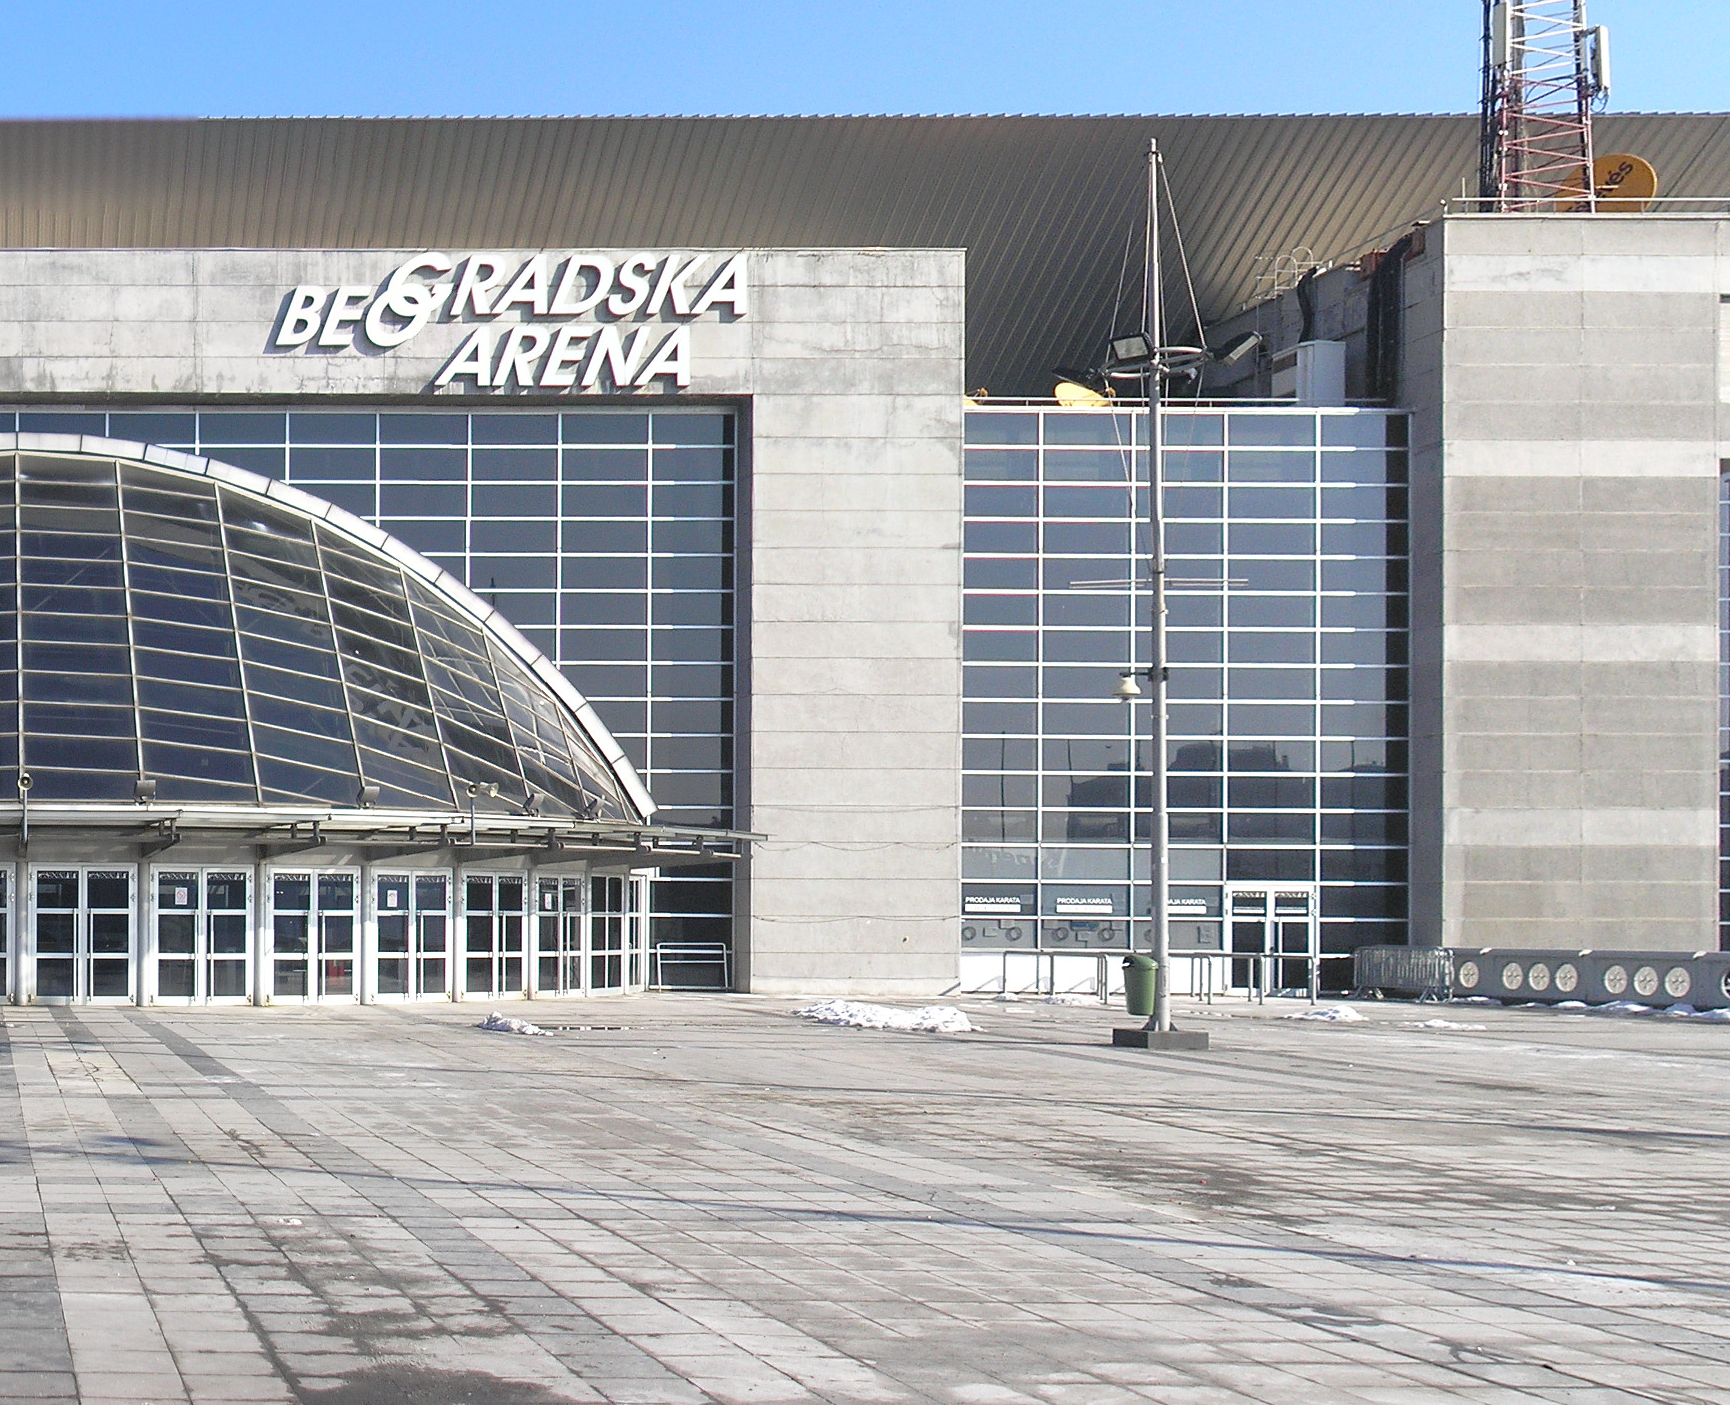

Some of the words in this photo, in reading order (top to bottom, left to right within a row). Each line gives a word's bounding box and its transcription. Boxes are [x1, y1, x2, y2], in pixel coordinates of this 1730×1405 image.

[275, 251, 748, 347] BEOGRADSKA
[434, 325, 692, 388] ARENA
[965, 896, 995, 904] PRODAJA
[995, 896, 1021, 904] KARATA
[1056, 897, 1087, 905] PRODAJA
[1087, 897, 1113, 905] KARATA
[1181, 898, 1206, 906] KARATA
